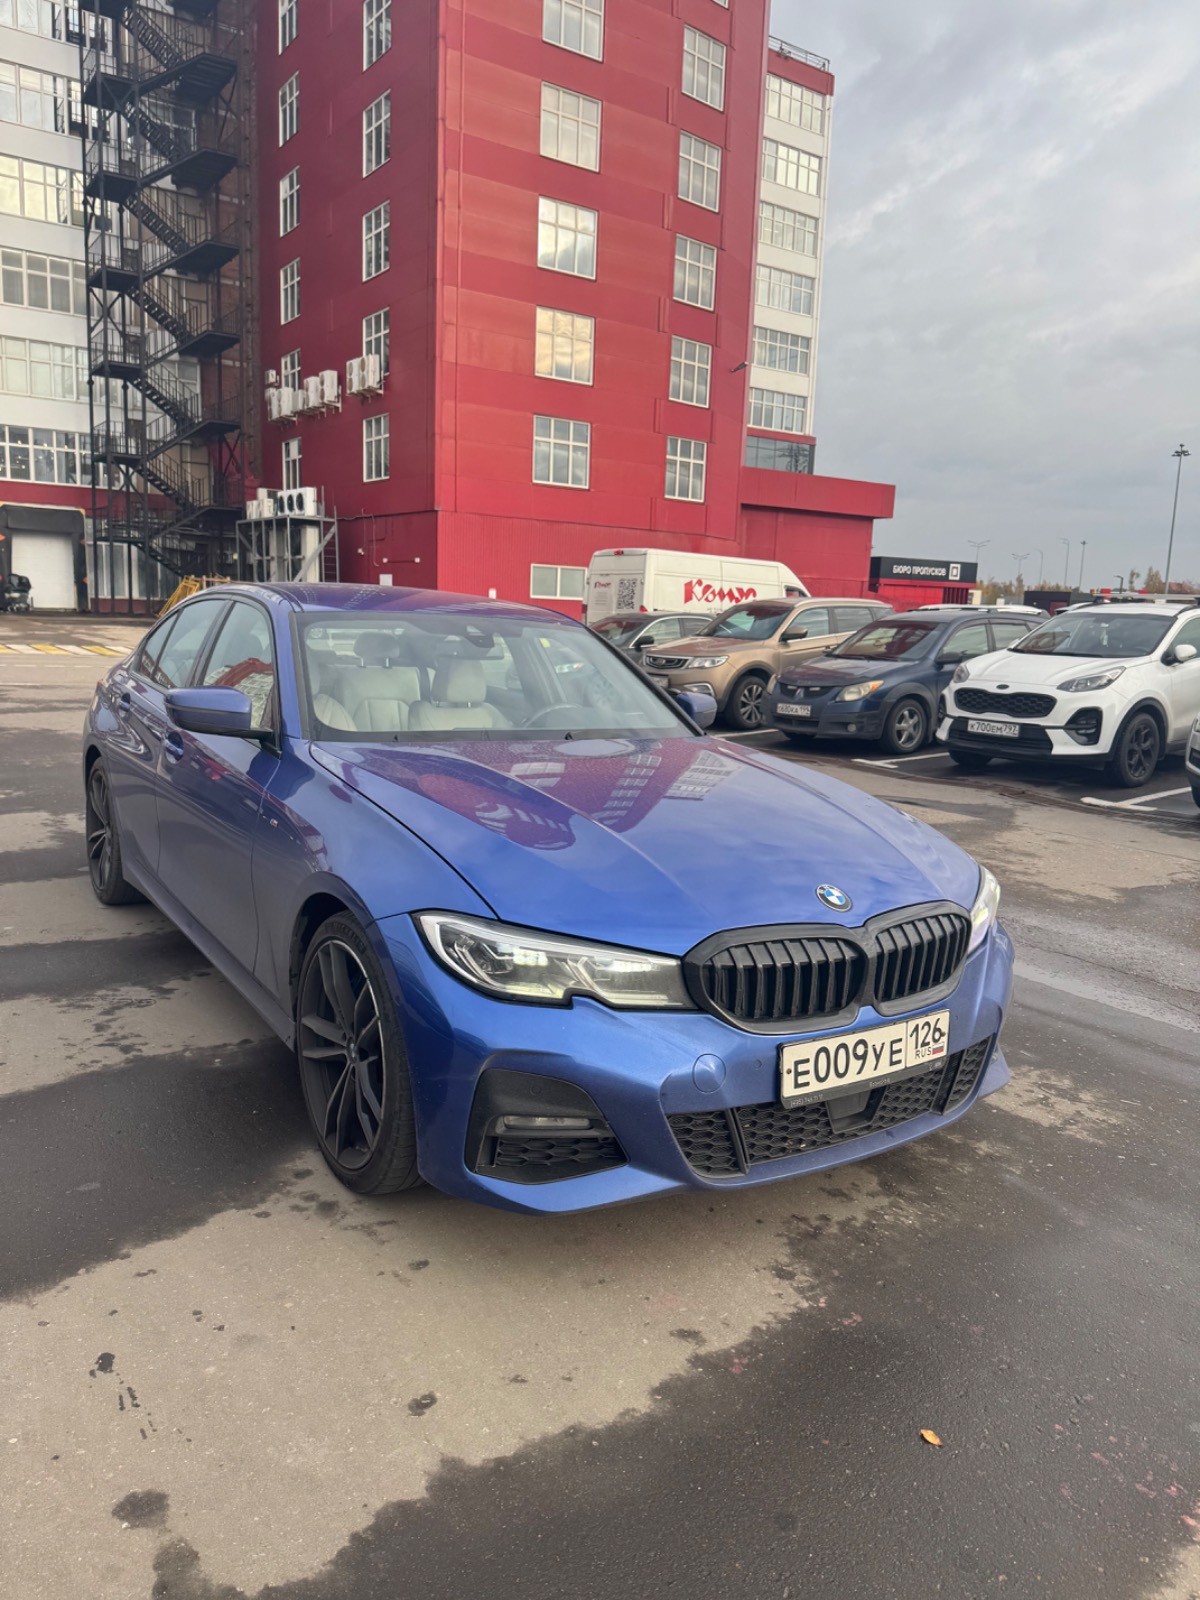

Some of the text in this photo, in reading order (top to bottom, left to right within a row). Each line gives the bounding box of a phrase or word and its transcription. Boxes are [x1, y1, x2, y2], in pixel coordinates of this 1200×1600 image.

[892, 565, 947, 576] БЮРО ПРОПУСКОВ
[793, 1017, 943, 1090] Е009УЕ 126
[914, 1046, 932, 1060] RUS
